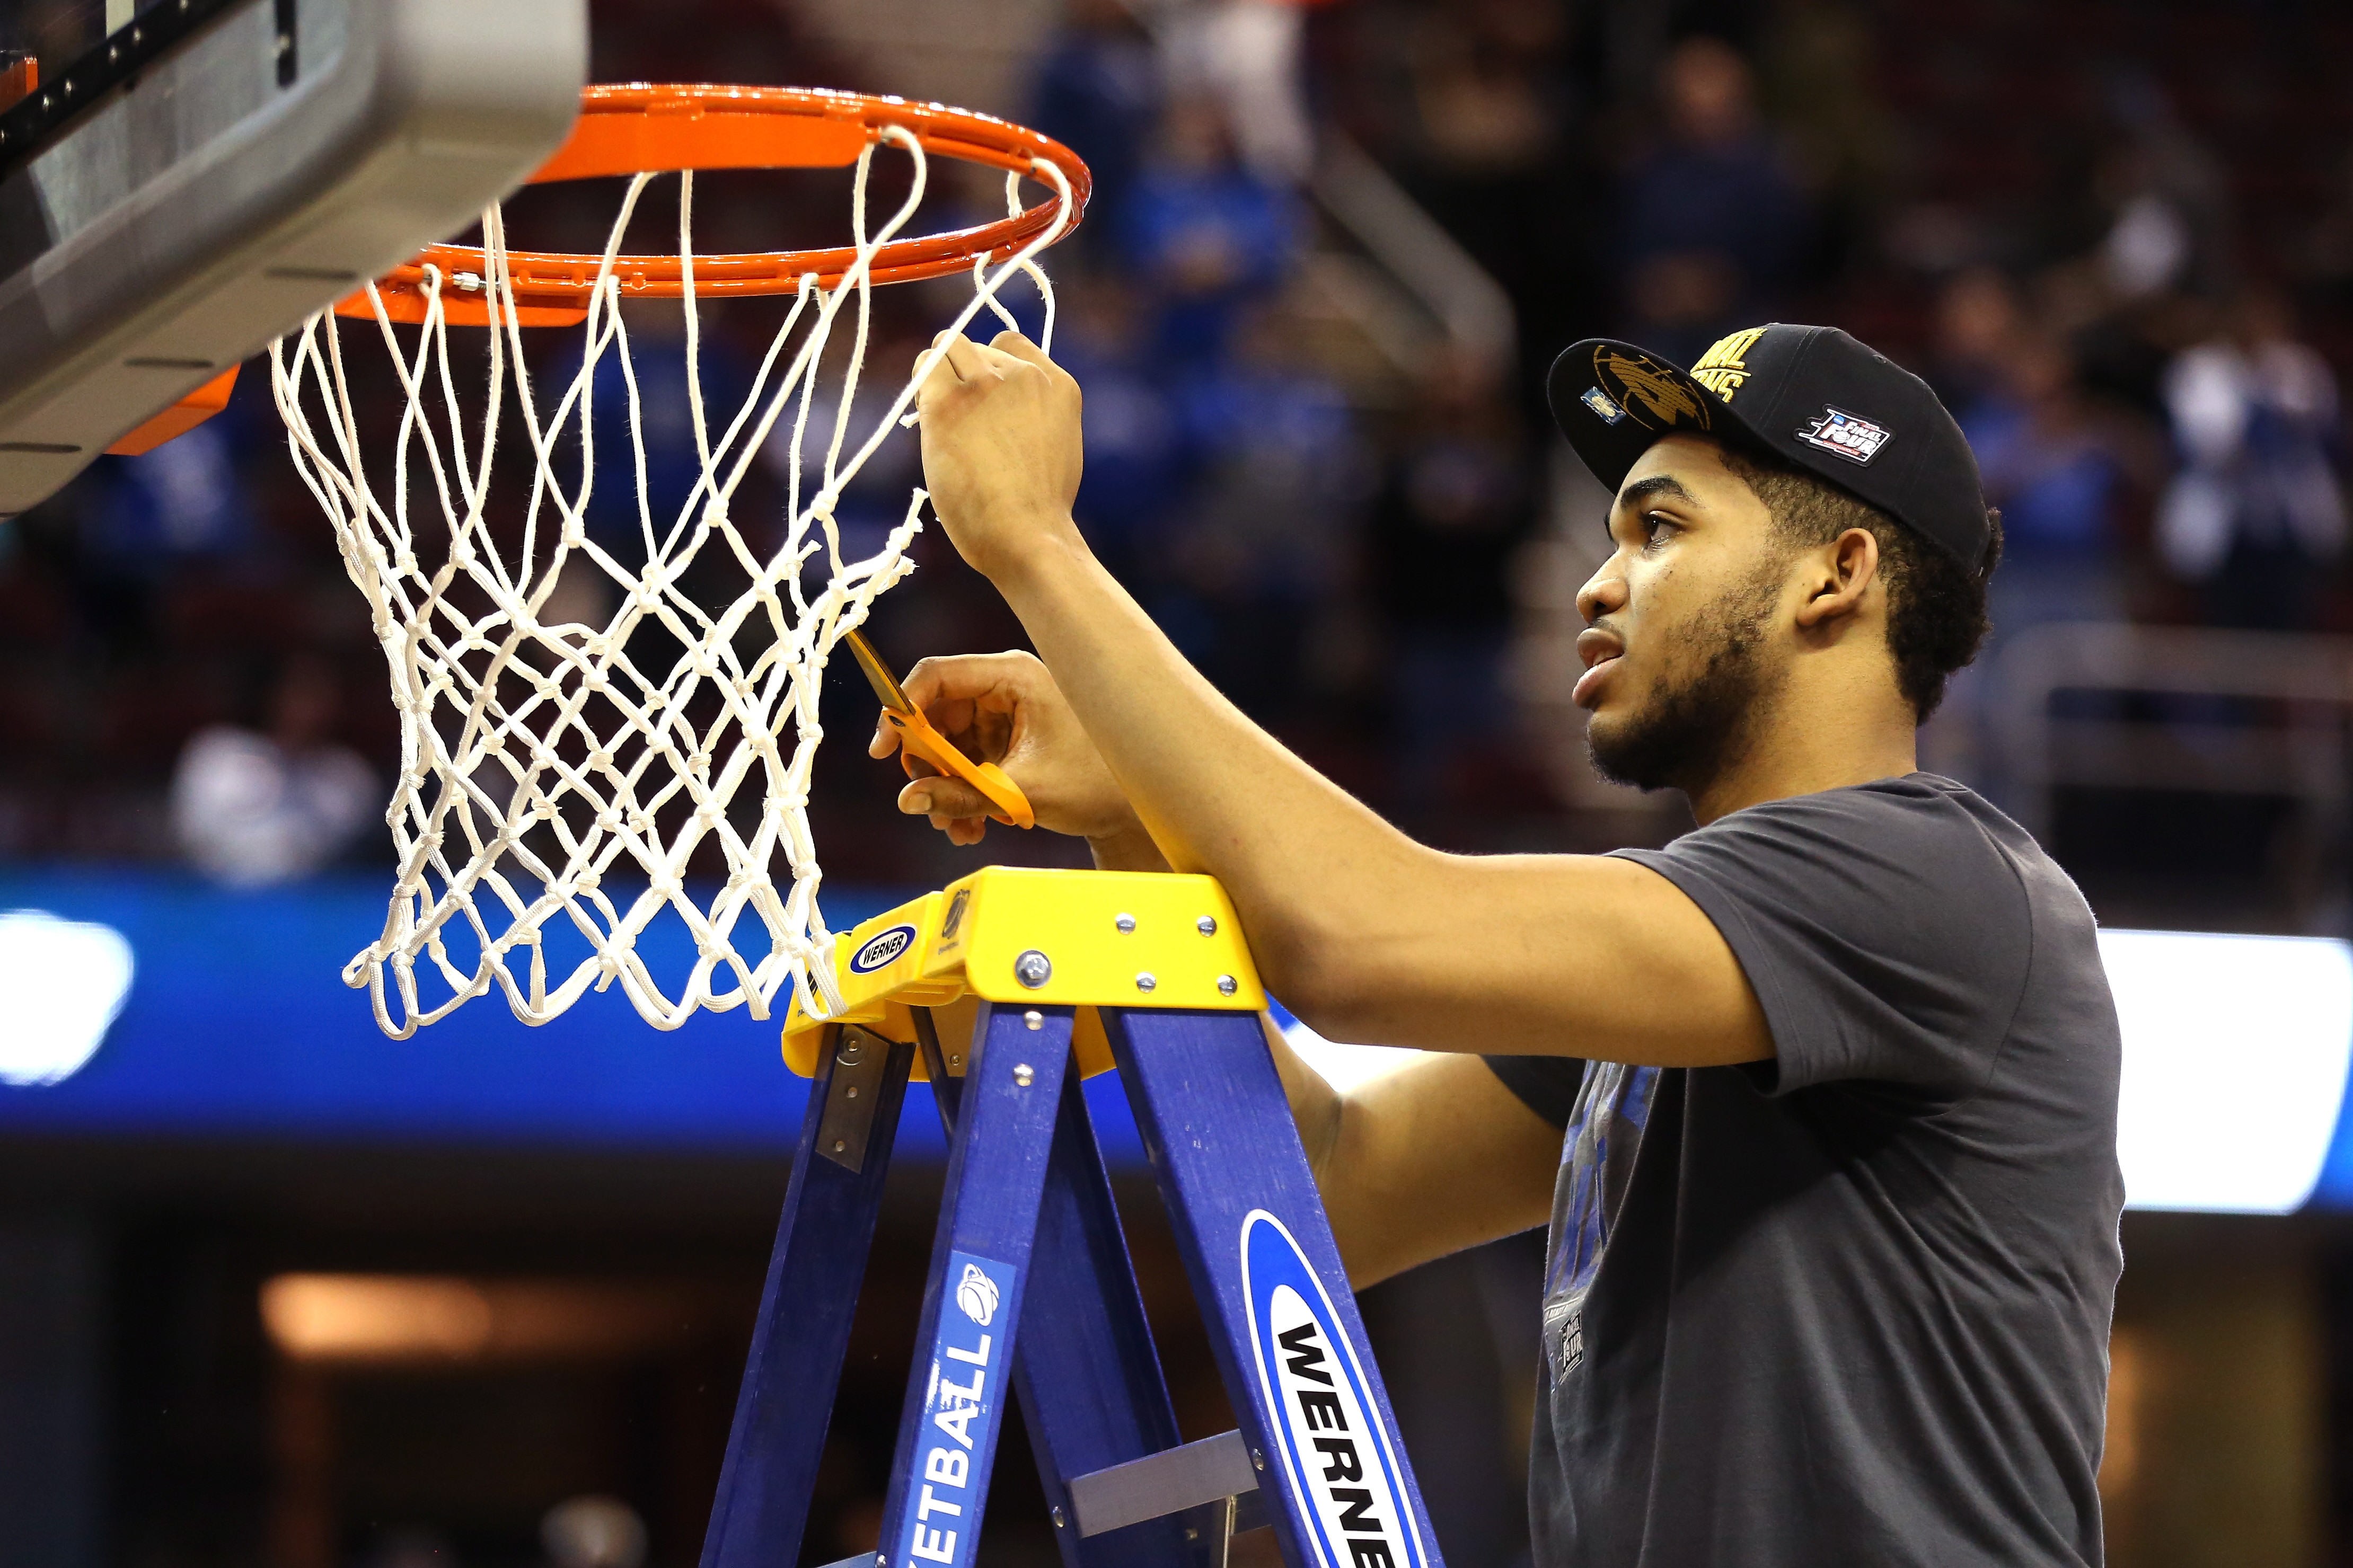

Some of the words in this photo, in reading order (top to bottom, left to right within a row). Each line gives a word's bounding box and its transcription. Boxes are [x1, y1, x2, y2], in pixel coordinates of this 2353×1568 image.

[1820, 424, 1877, 454] FOUR
[1844, 421, 1882, 441] FINAL
[863, 934, 904, 965] WERNER
[909, 1334, 991, 1568] ETBALL
